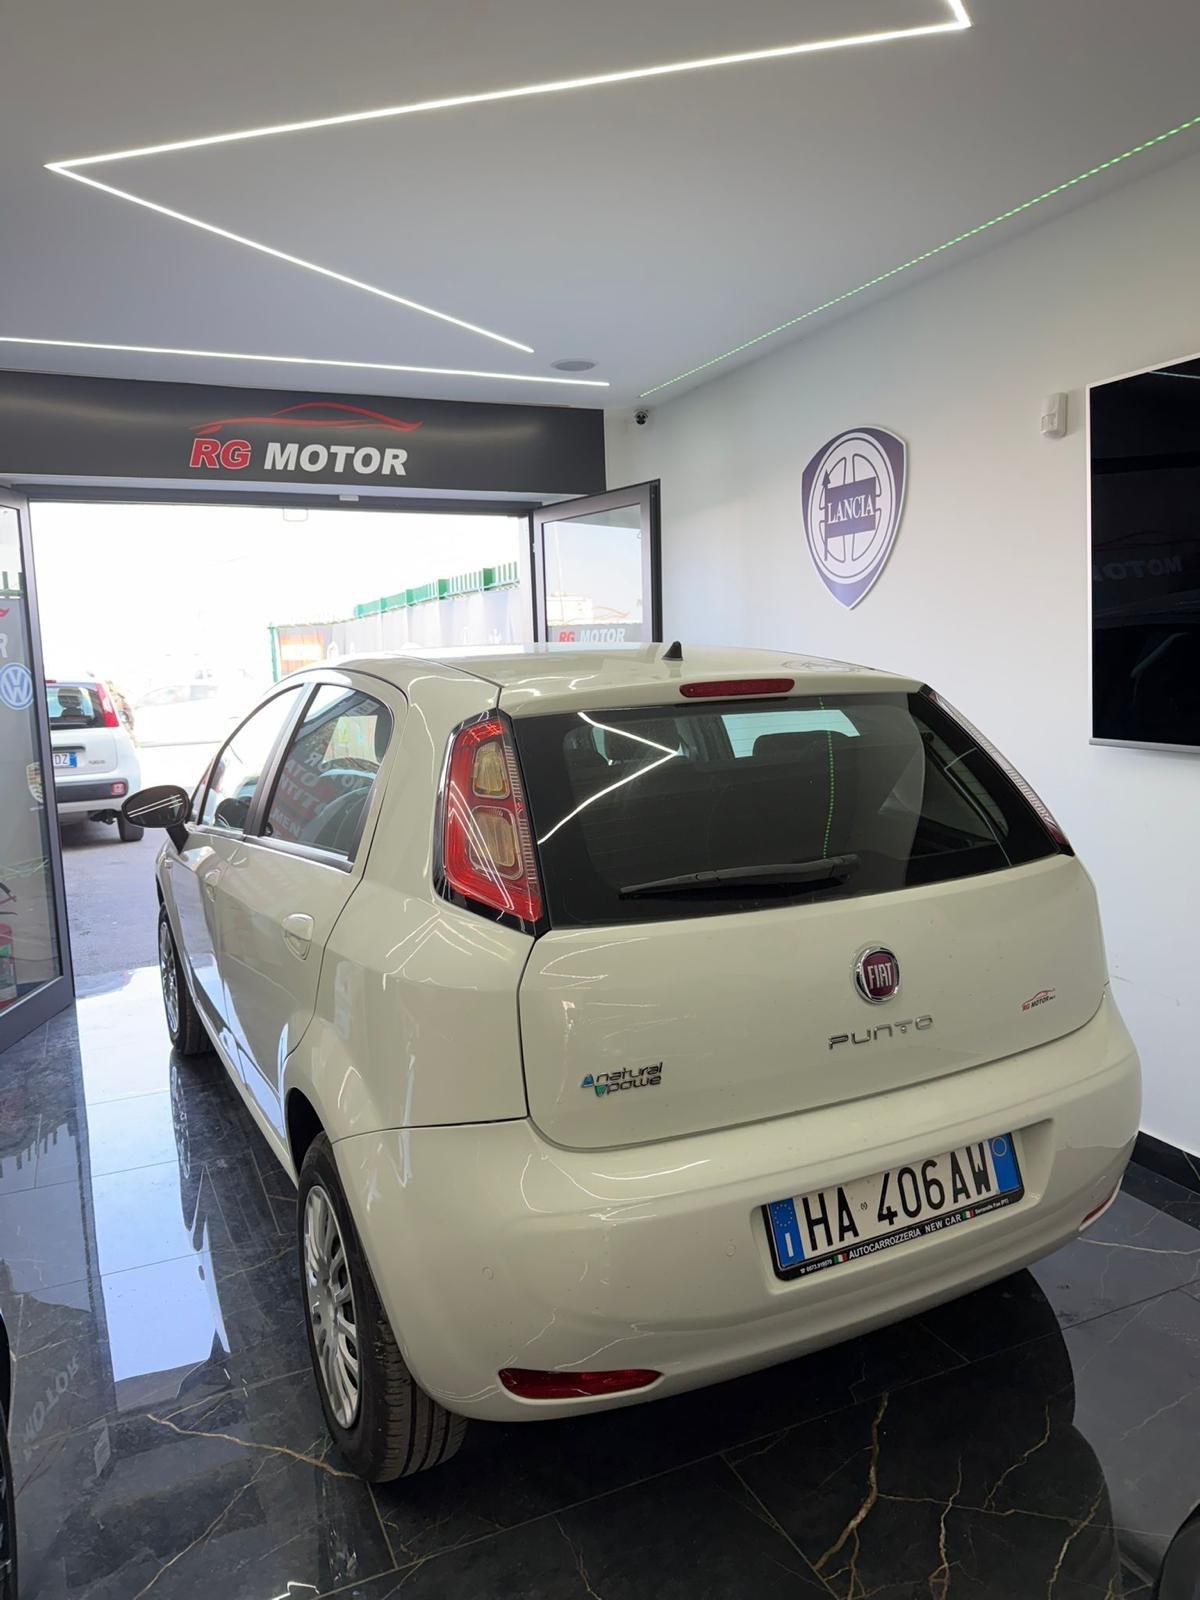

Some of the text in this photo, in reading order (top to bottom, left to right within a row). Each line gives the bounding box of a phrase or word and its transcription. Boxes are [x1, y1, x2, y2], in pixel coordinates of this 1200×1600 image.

[190, 438, 408, 475] RG MOTOR
[827, 494, 874, 524] LANCIA
[559, 627, 626, 643] RG MOTOR
[867, 963, 892, 989] FIAT
[828, 1015, 933, 1050] PUNTO
[596, 1062, 663, 1082] natural
[849, 1214, 962, 1259] AUTOCARROZZERIA NEW CAR
